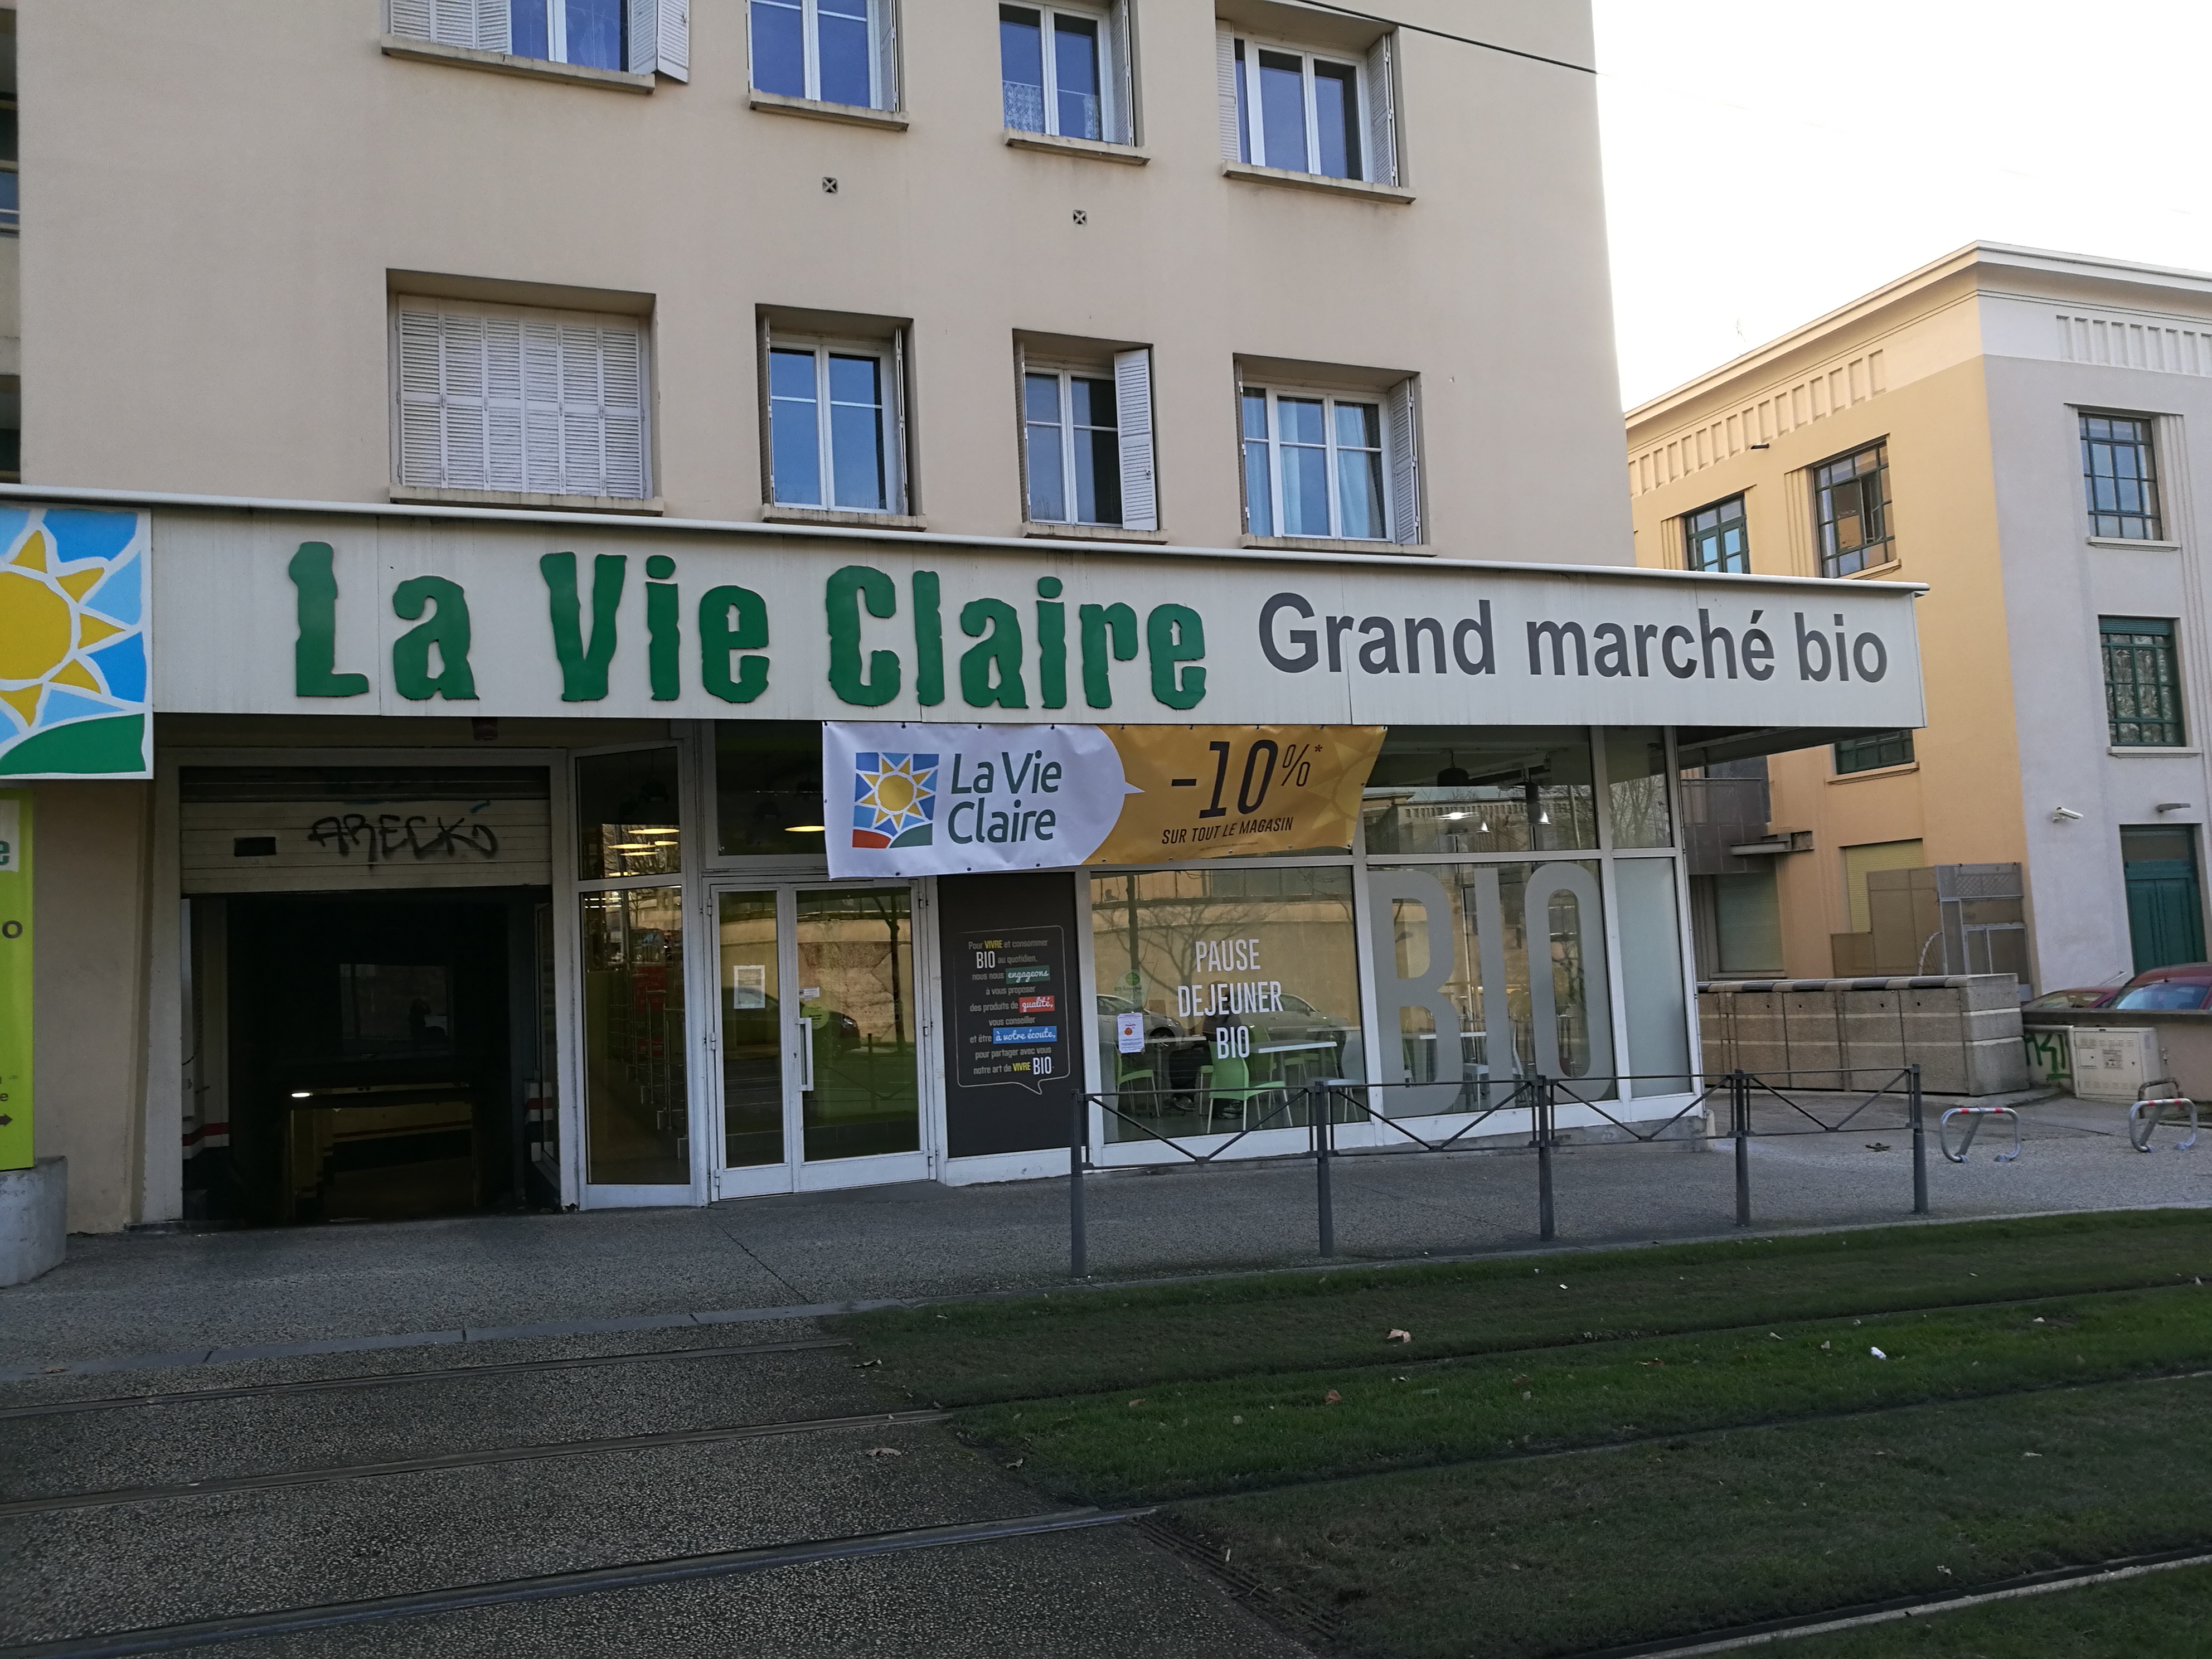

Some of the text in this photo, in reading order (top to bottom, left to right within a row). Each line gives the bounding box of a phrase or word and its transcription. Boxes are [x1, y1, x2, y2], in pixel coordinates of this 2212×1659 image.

[289, 541, 1208, 711] La Vie Claire
[1259, 592, 1888, 684] Grand marché bio
[951, 750, 1062, 794] La Vie
[948, 797, 1056, 845] Claire
[1162, 817, 1293, 844] SUR TOUT LE MAGASIN
[984, 940, 1002, 949] VIVRE
[976, 950, 996, 969] BIO
[1196, 939, 1261, 972] PAUSE
[1008, 970, 1049, 983] engageons
[1008, 986, 1036, 996] proposer
[1367, 862, 1614, 1116] BIO
[983, 1002, 1009, 1013] produits
[1006, 1016, 1036, 1025] conseiller
[996, 1031, 1002, 1041] à
[1004, 1030, 1026, 1041] votre
[1216, 1025, 1250, 1059] BIO
[976, 1051, 990, 1060] pour
[991, 1049, 1018, 1059] partager
[1012, 1062, 1031, 1071] VIVRE
